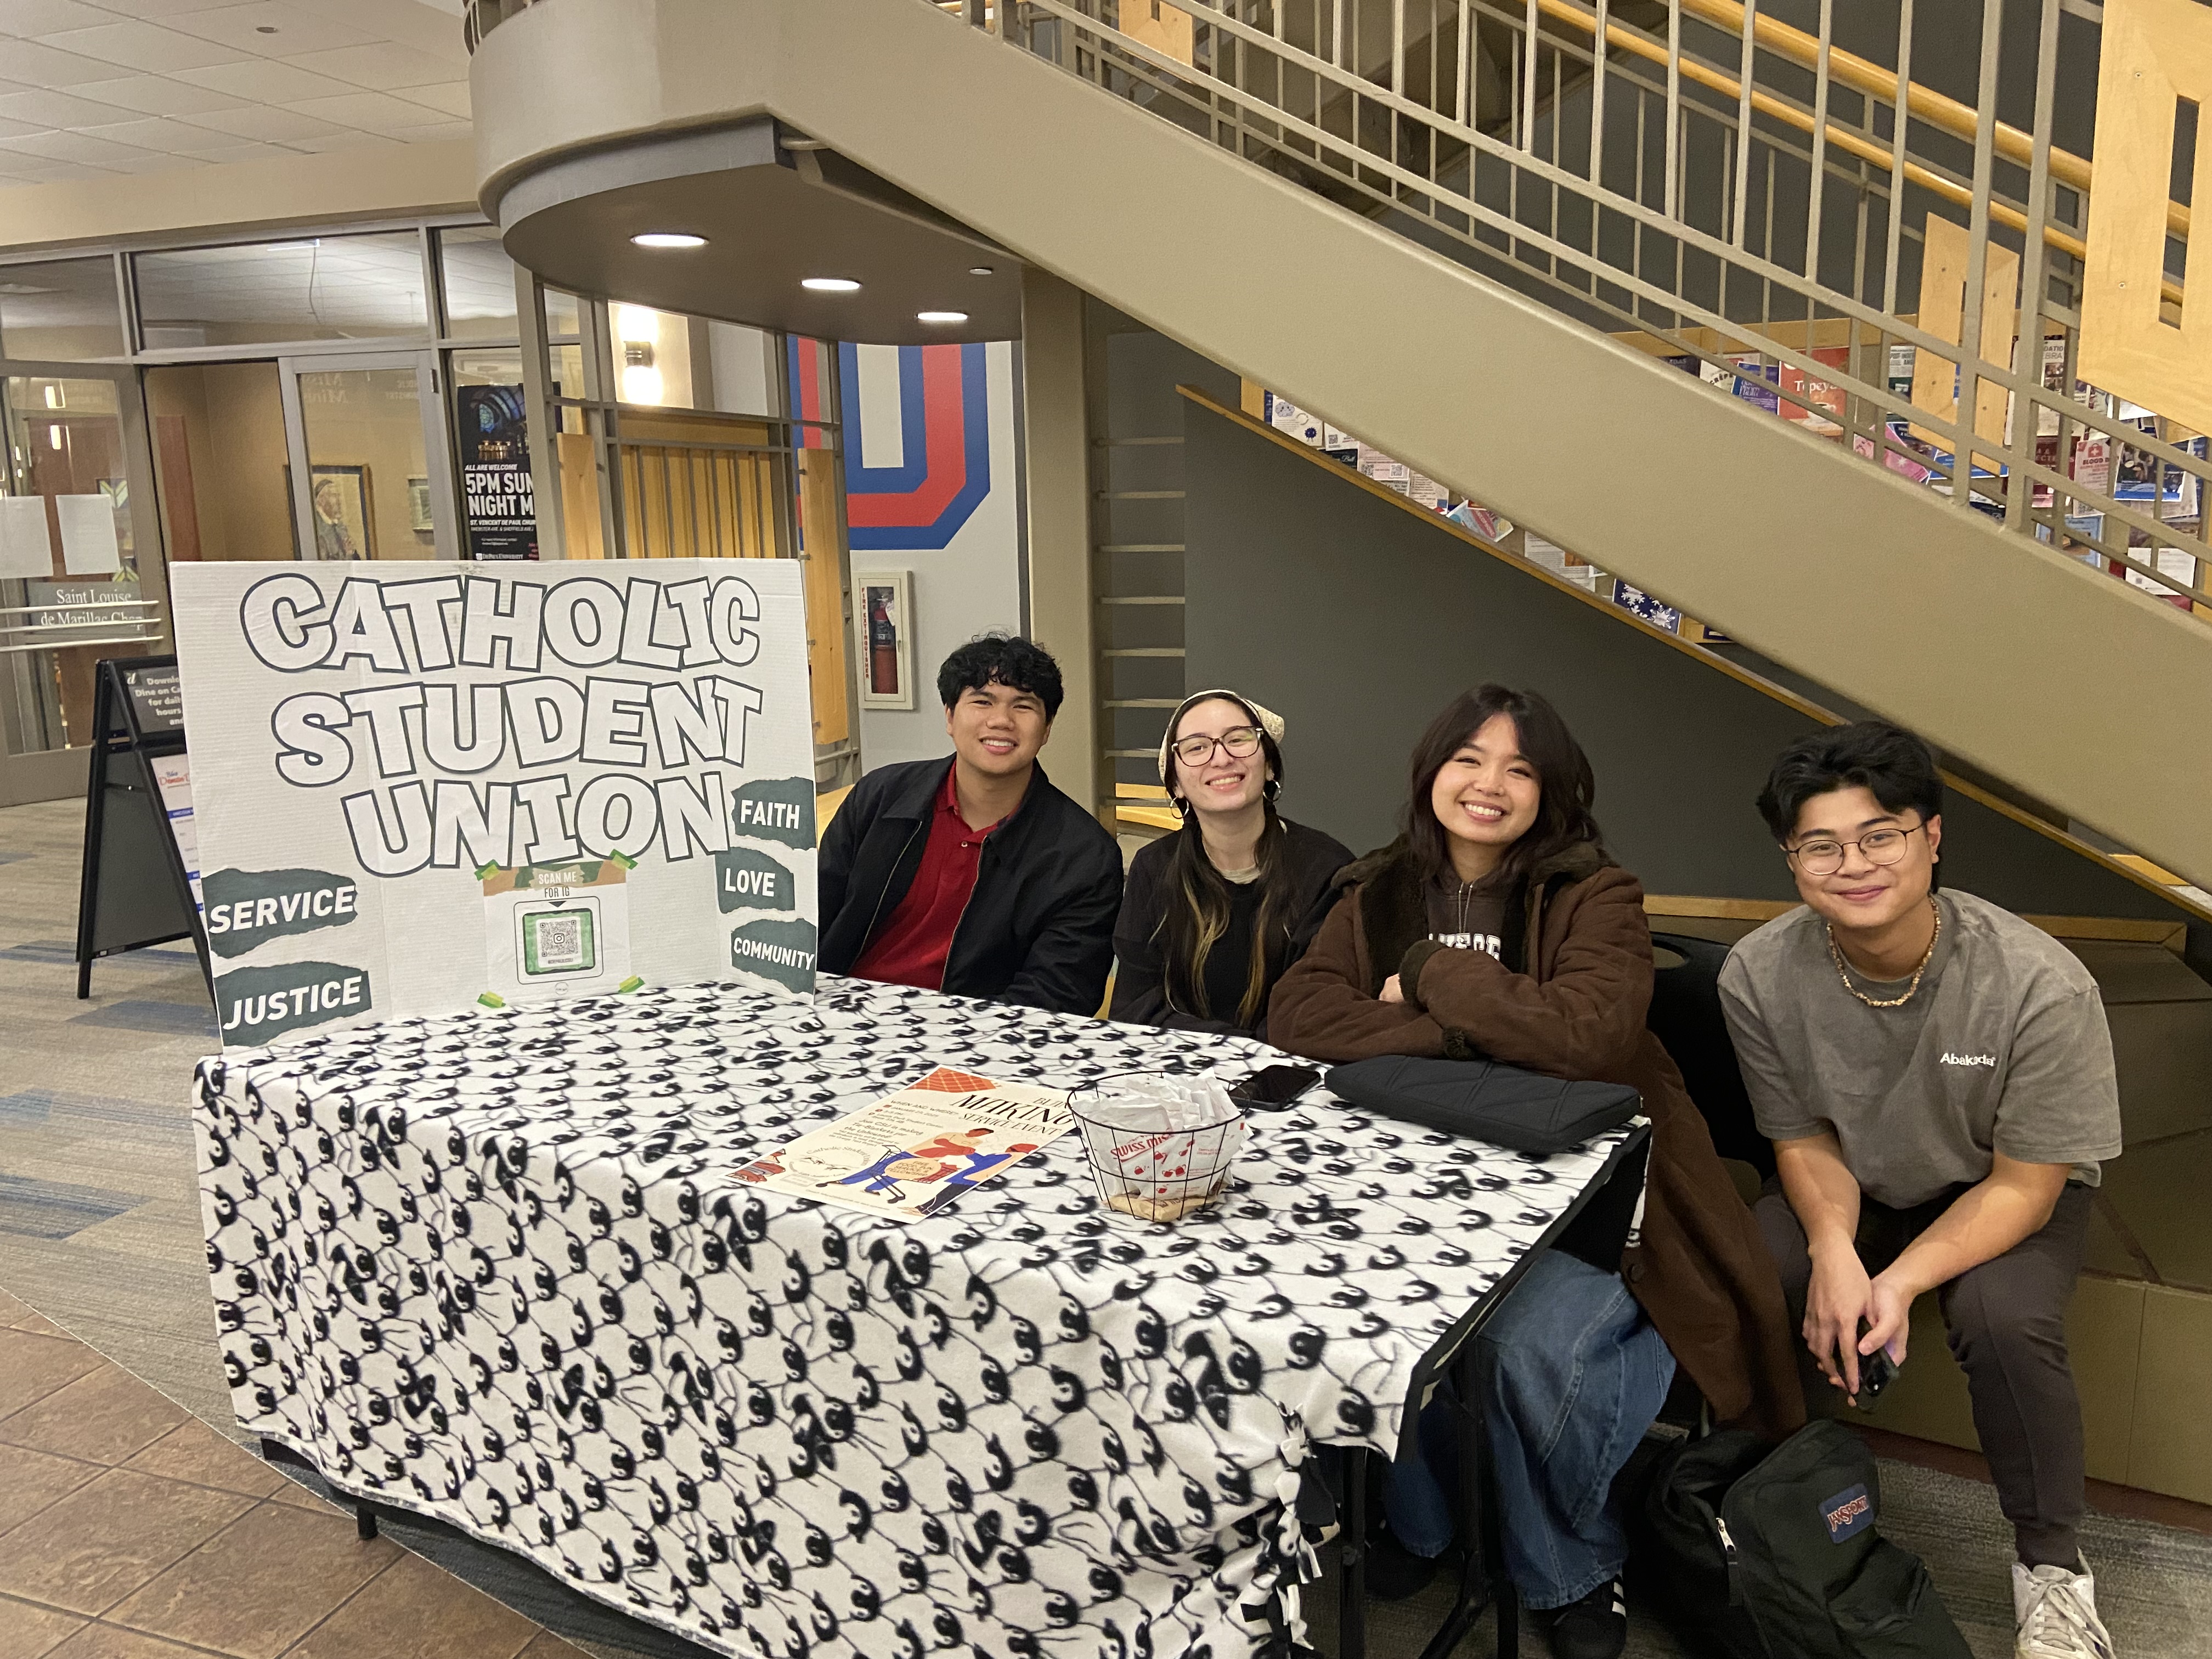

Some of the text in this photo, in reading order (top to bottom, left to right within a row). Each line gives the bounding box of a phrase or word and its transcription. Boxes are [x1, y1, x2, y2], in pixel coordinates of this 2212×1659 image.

[465, 472, 533, 494] 5PM SUN
[468, 495, 534, 516] NIGHT M
[56, 589, 132, 604] Saint Louise
[41, 612, 55, 625] de
[57, 612, 108, 625] Marillac
[240, 572, 760, 674] CATHOLIC
[134, 689, 156, 697] Dine
[271, 674, 763, 787] STUDENT
[341, 771, 730, 878] UNION
[740, 799, 800, 830] FAITH
[538, 872, 577, 885] SCAN ME
[725, 867, 776, 897] LOVE
[544, 887, 570, 898] FOR IG
[208, 885, 356, 934] SERVICE
[733, 936, 815, 970] COMMUNITY
[223, 975, 362, 1030] JUSTICE
[950, 1094, 1074, 1125] MAKING
[852, 1122, 894, 1134] Tie-Blankets
[899, 1127, 924, 1136] making
[961, 1113, 1063, 1135] SERVICE EVENT
[806, 1146, 842, 1154] Catholic
[885, 1167, 928, 1176] FELLOWSHIP
